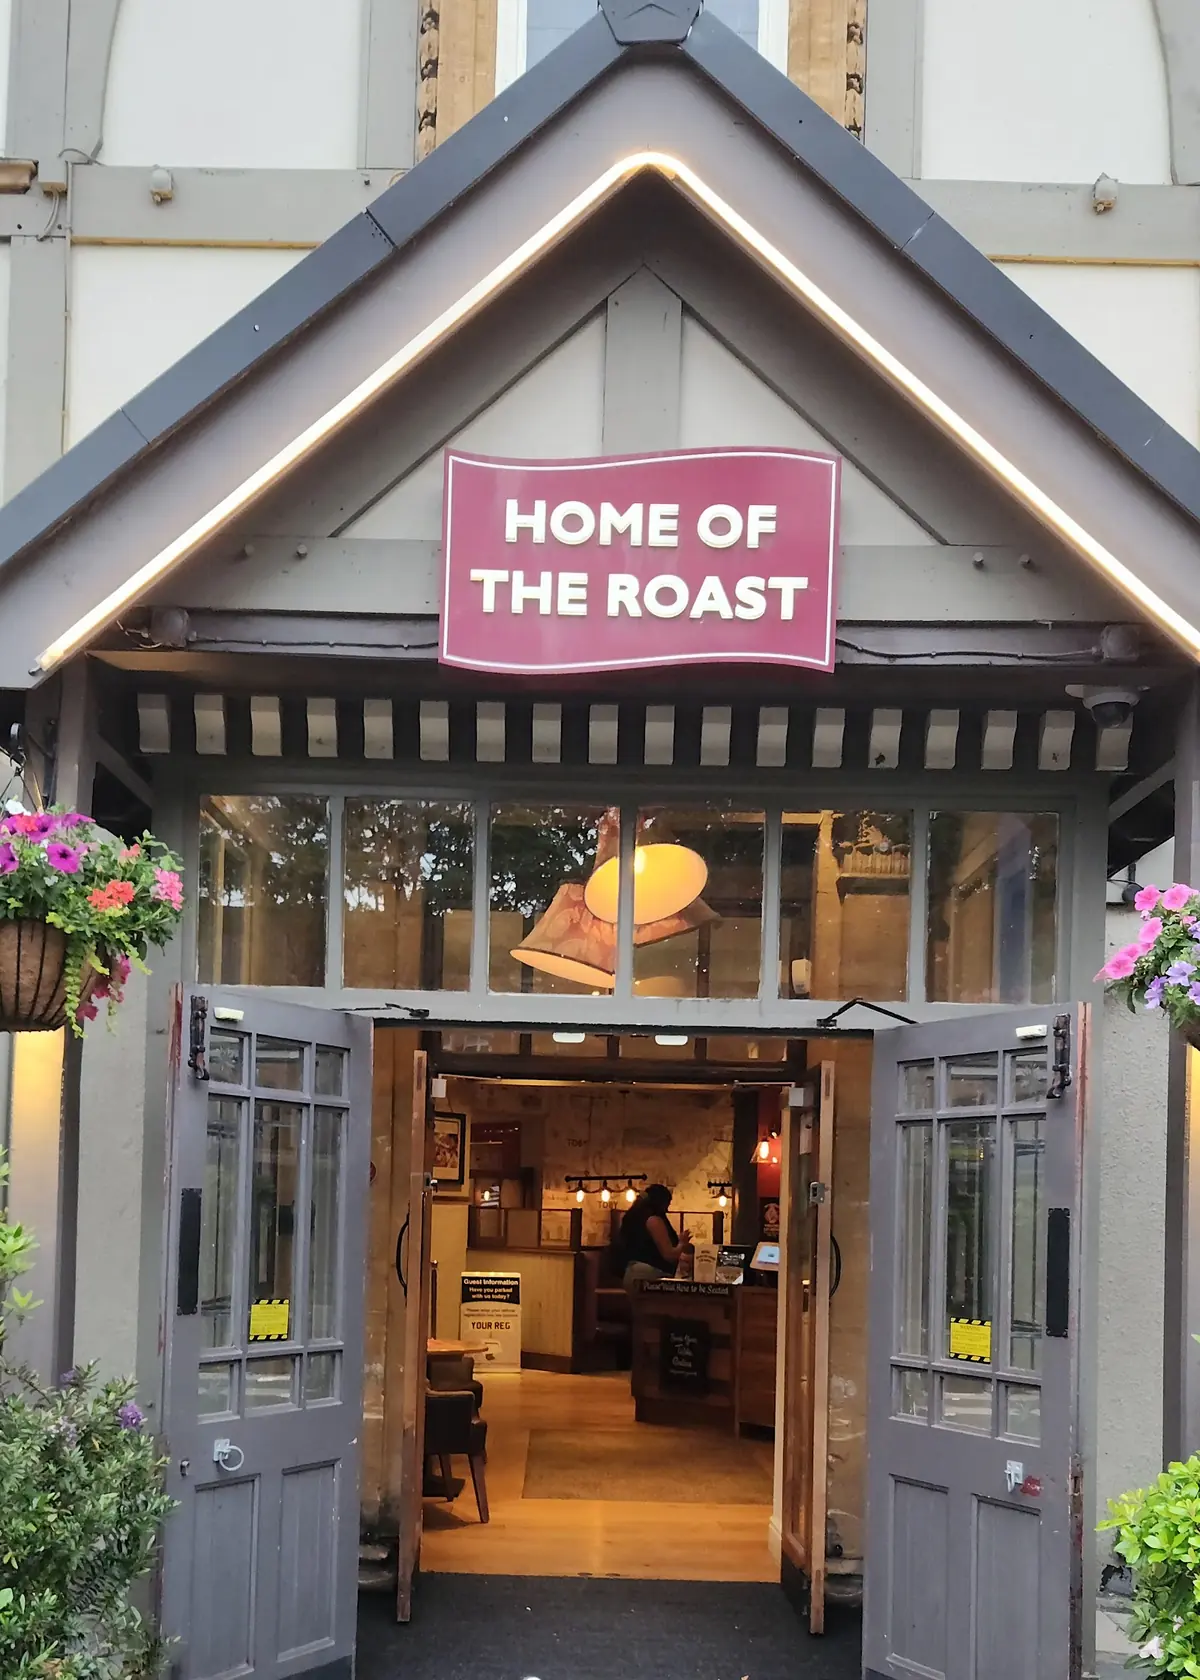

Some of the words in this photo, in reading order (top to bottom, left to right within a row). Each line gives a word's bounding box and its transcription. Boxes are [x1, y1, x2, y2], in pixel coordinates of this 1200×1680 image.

[505, 499, 679, 547] HOME
[697, 503, 777, 548] OF
[470, 568, 588, 616] THE
[607, 573, 809, 621] ROAST
[483, 1278, 519, 1286] Information
[471, 1321, 492, 1330] YOUR
[494, 1321, 511, 1330] REG
